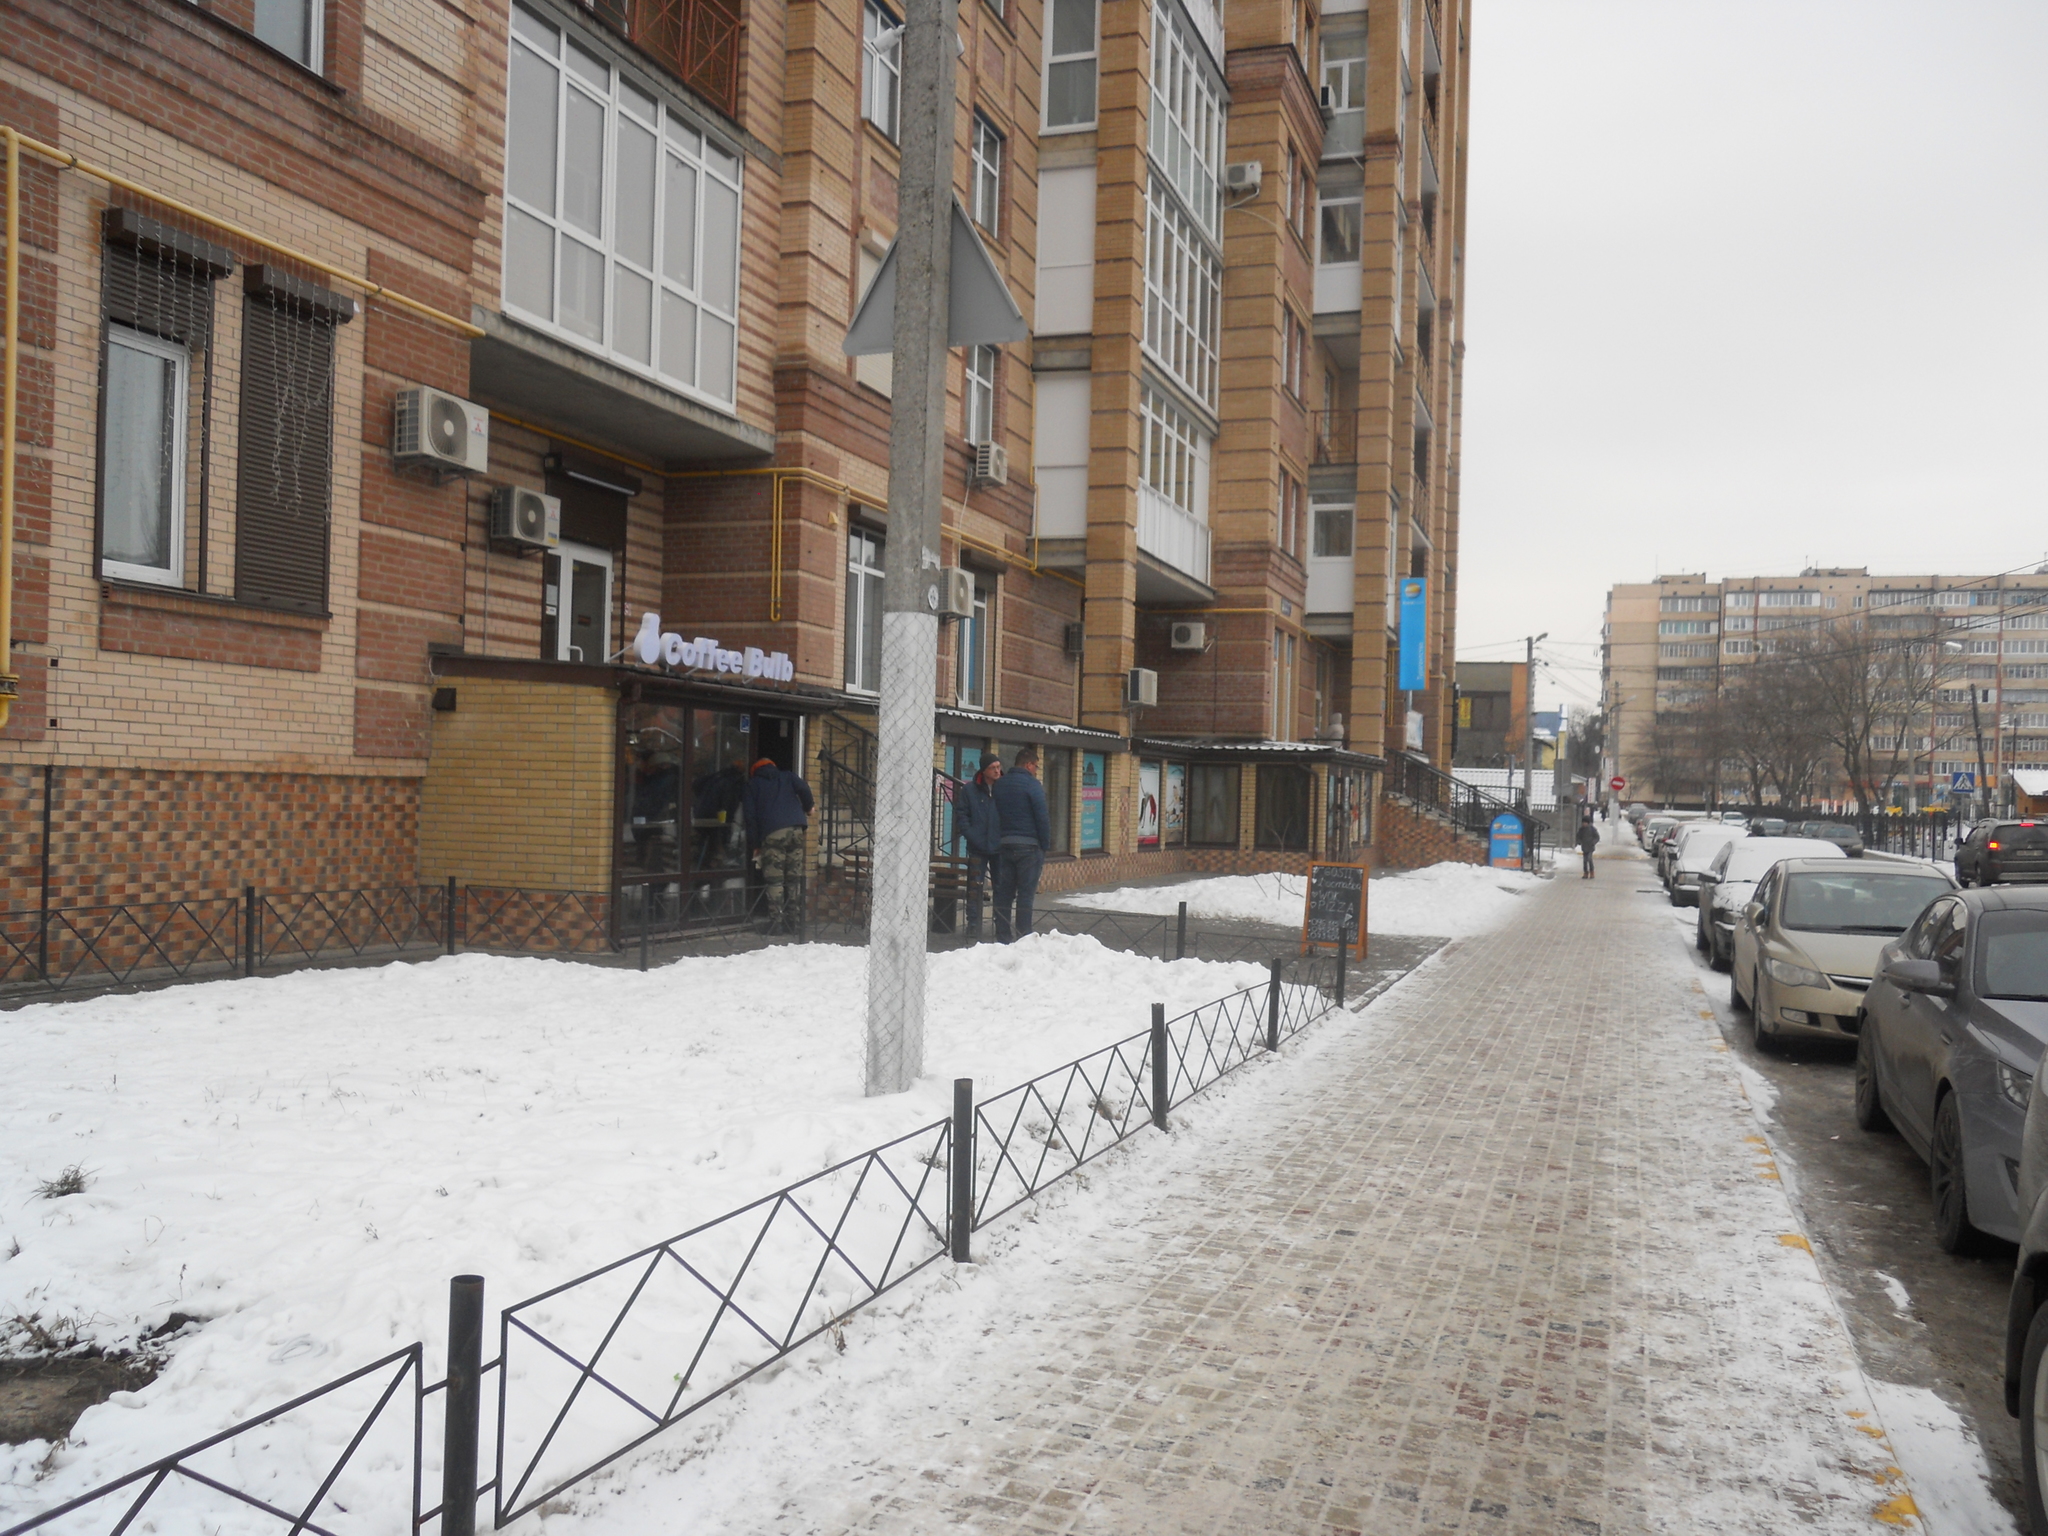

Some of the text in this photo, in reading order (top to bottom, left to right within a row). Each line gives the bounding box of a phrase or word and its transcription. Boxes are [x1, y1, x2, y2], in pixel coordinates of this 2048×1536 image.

[660, 632, 794, 683] Coffee Bulb
[1318, 900, 1354, 913] PIZZA
